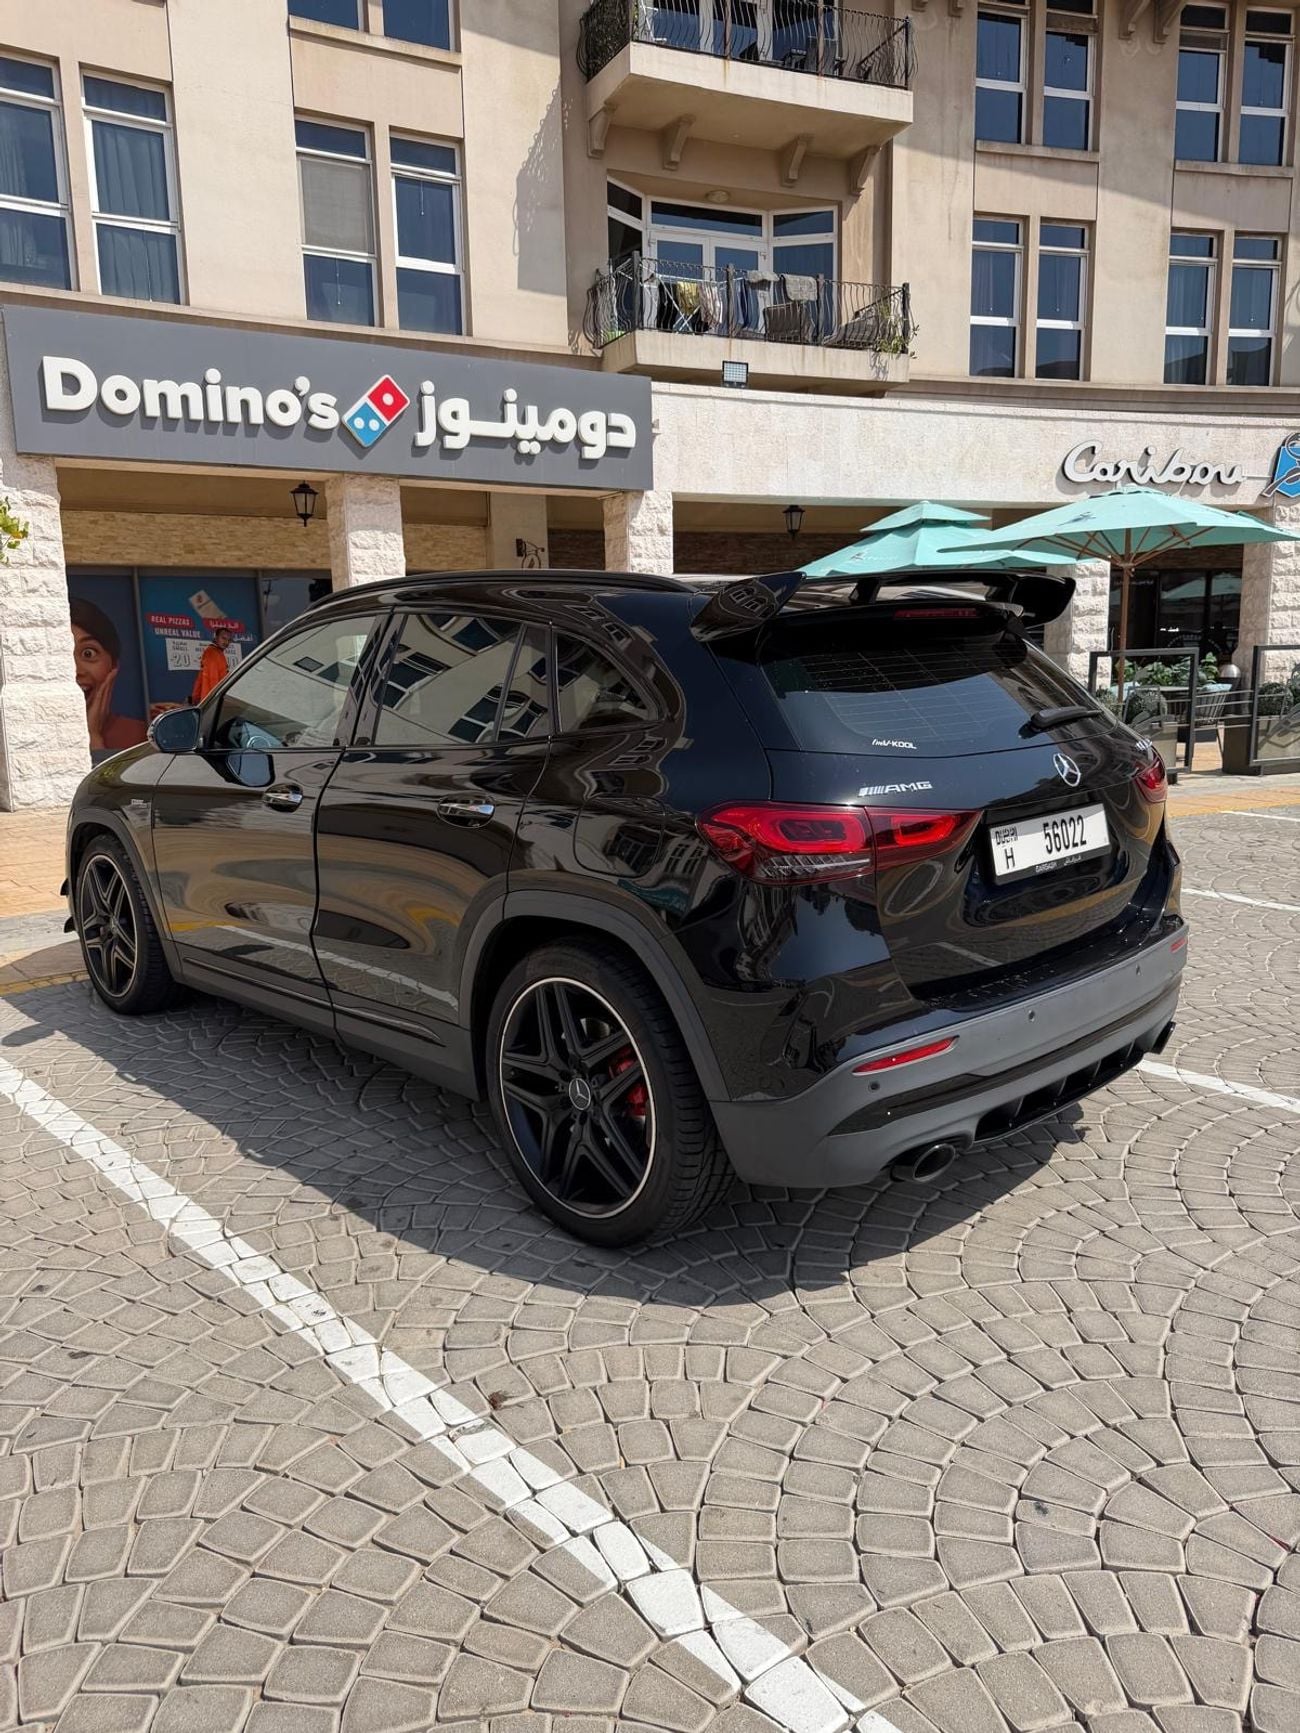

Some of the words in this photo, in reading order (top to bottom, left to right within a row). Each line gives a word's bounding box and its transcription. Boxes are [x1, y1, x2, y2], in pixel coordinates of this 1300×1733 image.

[42, 355, 340, 430] Domino's
[415, 381, 637, 460] دومينوز
[1063, 439, 1246, 485] Caribou
[151, 615, 167, 624] REAL
[168, 617, 190, 626] PIZZAS
[154, 627, 180, 637] UNREAL
[885, 781, 933, 793] AMG
[1043, 815, 1087, 854] 56022
[1004, 847, 1016, 869] H
